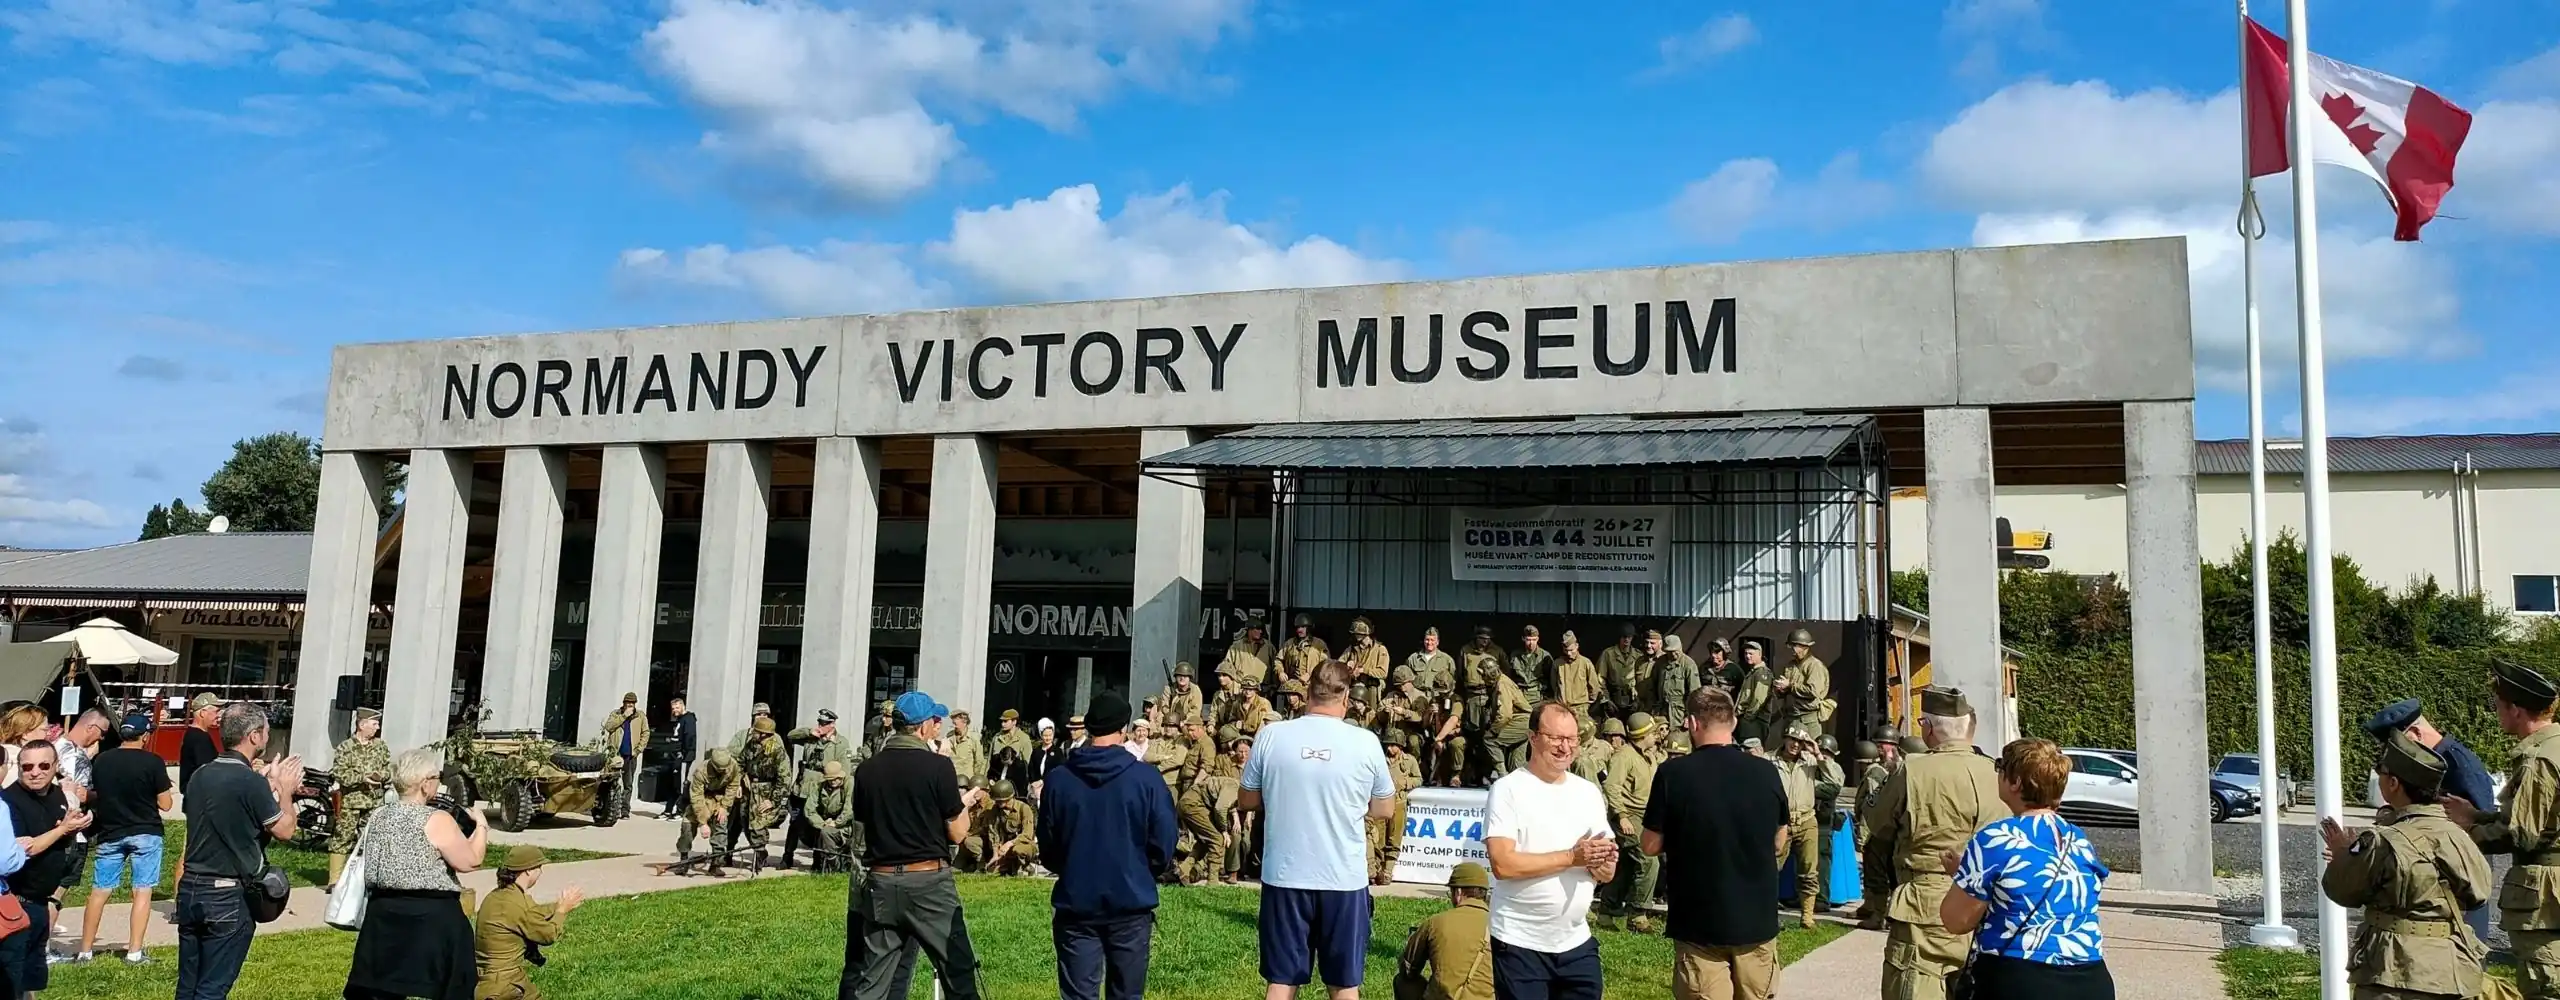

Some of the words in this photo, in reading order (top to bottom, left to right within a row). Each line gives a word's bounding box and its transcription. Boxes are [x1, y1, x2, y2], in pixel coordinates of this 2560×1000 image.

[442, 345, 827, 421] NORMANDY
[887, 323, 1248, 404] VICTORY
[1317, 298, 1737, 389] MUSEUM
[1464, 518, 1505, 528] Festival
[1507, 517, 1585, 528] commémoratif
[1593, 518, 1616, 532] 26
[1632, 518, 1655, 532] 27
[1464, 529, 1545, 547] COBRA
[1552, 529, 1586, 547] 44
[1592, 535, 1655, 548] JUILLET
[1464, 550, 1494, 560] MUSÉE
[1495, 551, 1528, 560] VIVANT
[1534, 551, 1560, 560] CAMP
[1562, 552, 1573, 560] DE
[1575, 552, 1655, 561] RECONSTITUTION
[992, 604, 1133, 637] NORMAN
[1407, 804, 1486, 818] mmémoratif
[1446, 820, 1482, 841] 44
[1423, 846, 1453, 856] CAMP
[1455, 849, 1469, 857] DE
[1416, 862, 1445, 870] MUSEUM
